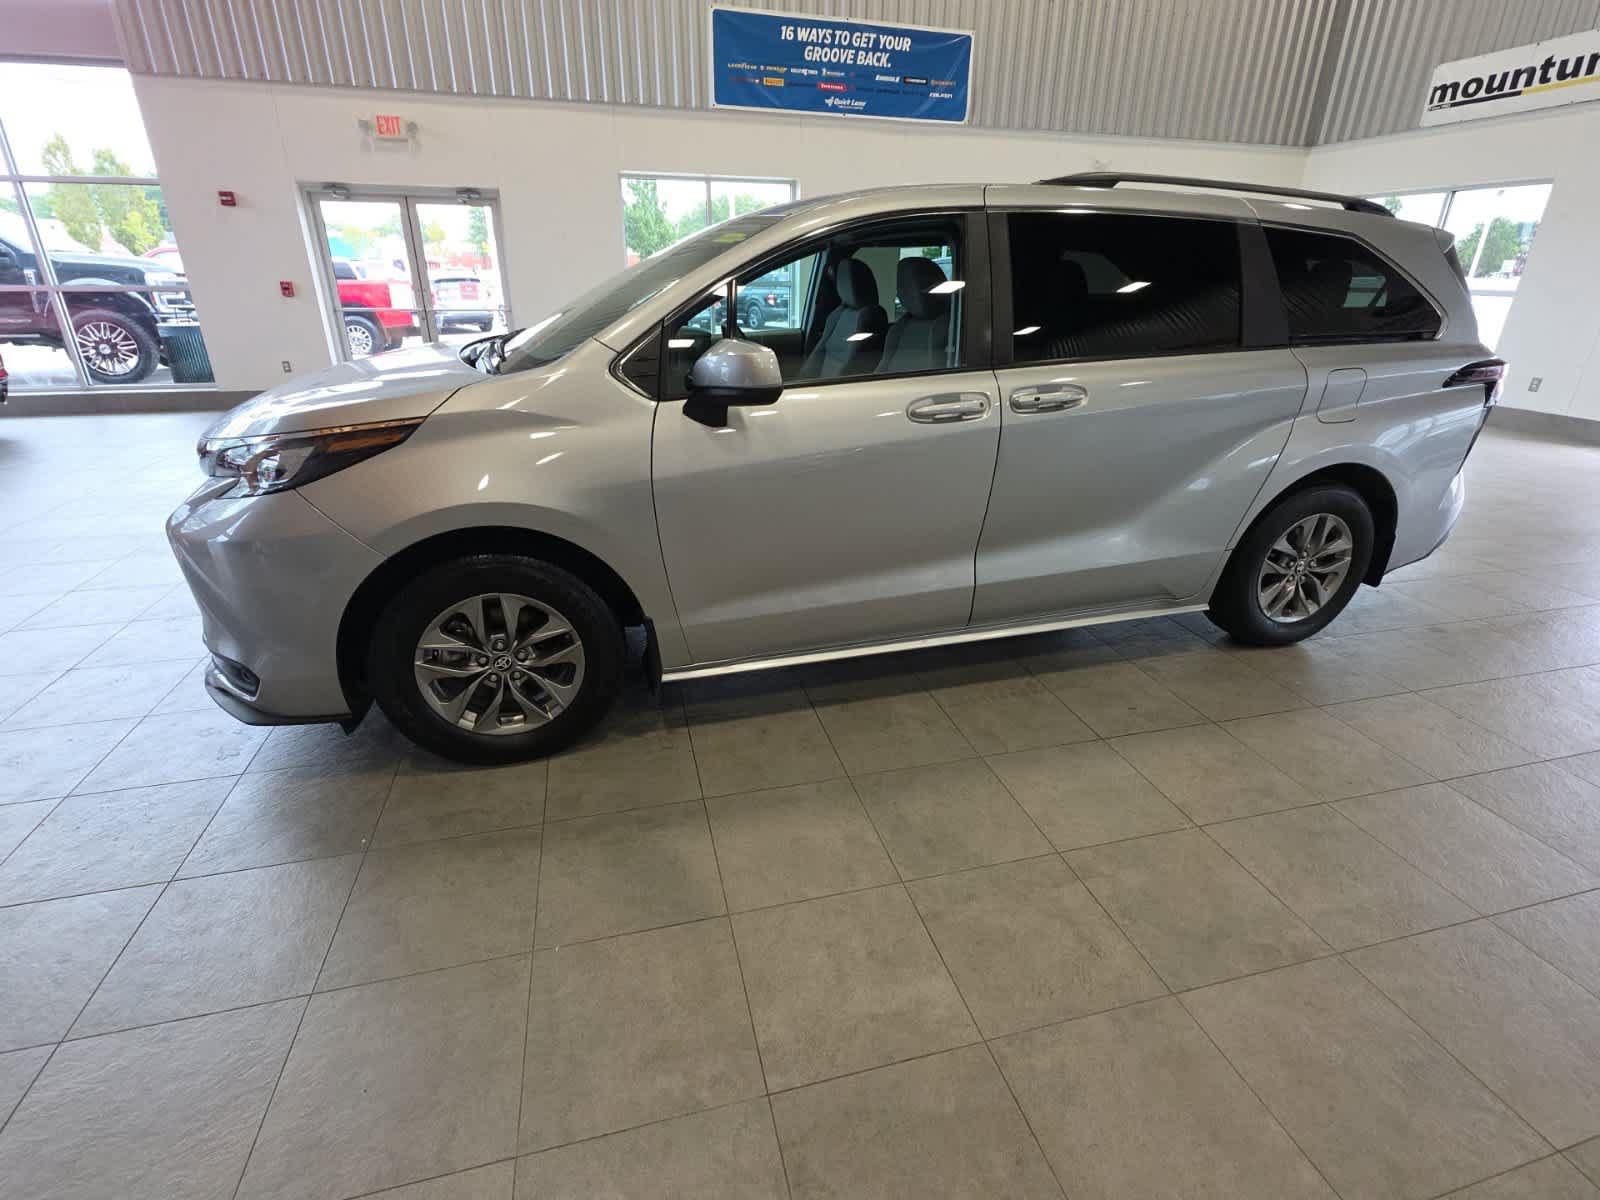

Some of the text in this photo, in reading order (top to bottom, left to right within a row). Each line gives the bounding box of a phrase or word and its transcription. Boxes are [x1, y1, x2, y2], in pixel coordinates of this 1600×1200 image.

[781, 26, 911, 52] 16 WAYS TO GET YOUR
[804, 45, 891, 68] GROOVE BACK.
[376, 115, 401, 136] EXIT
